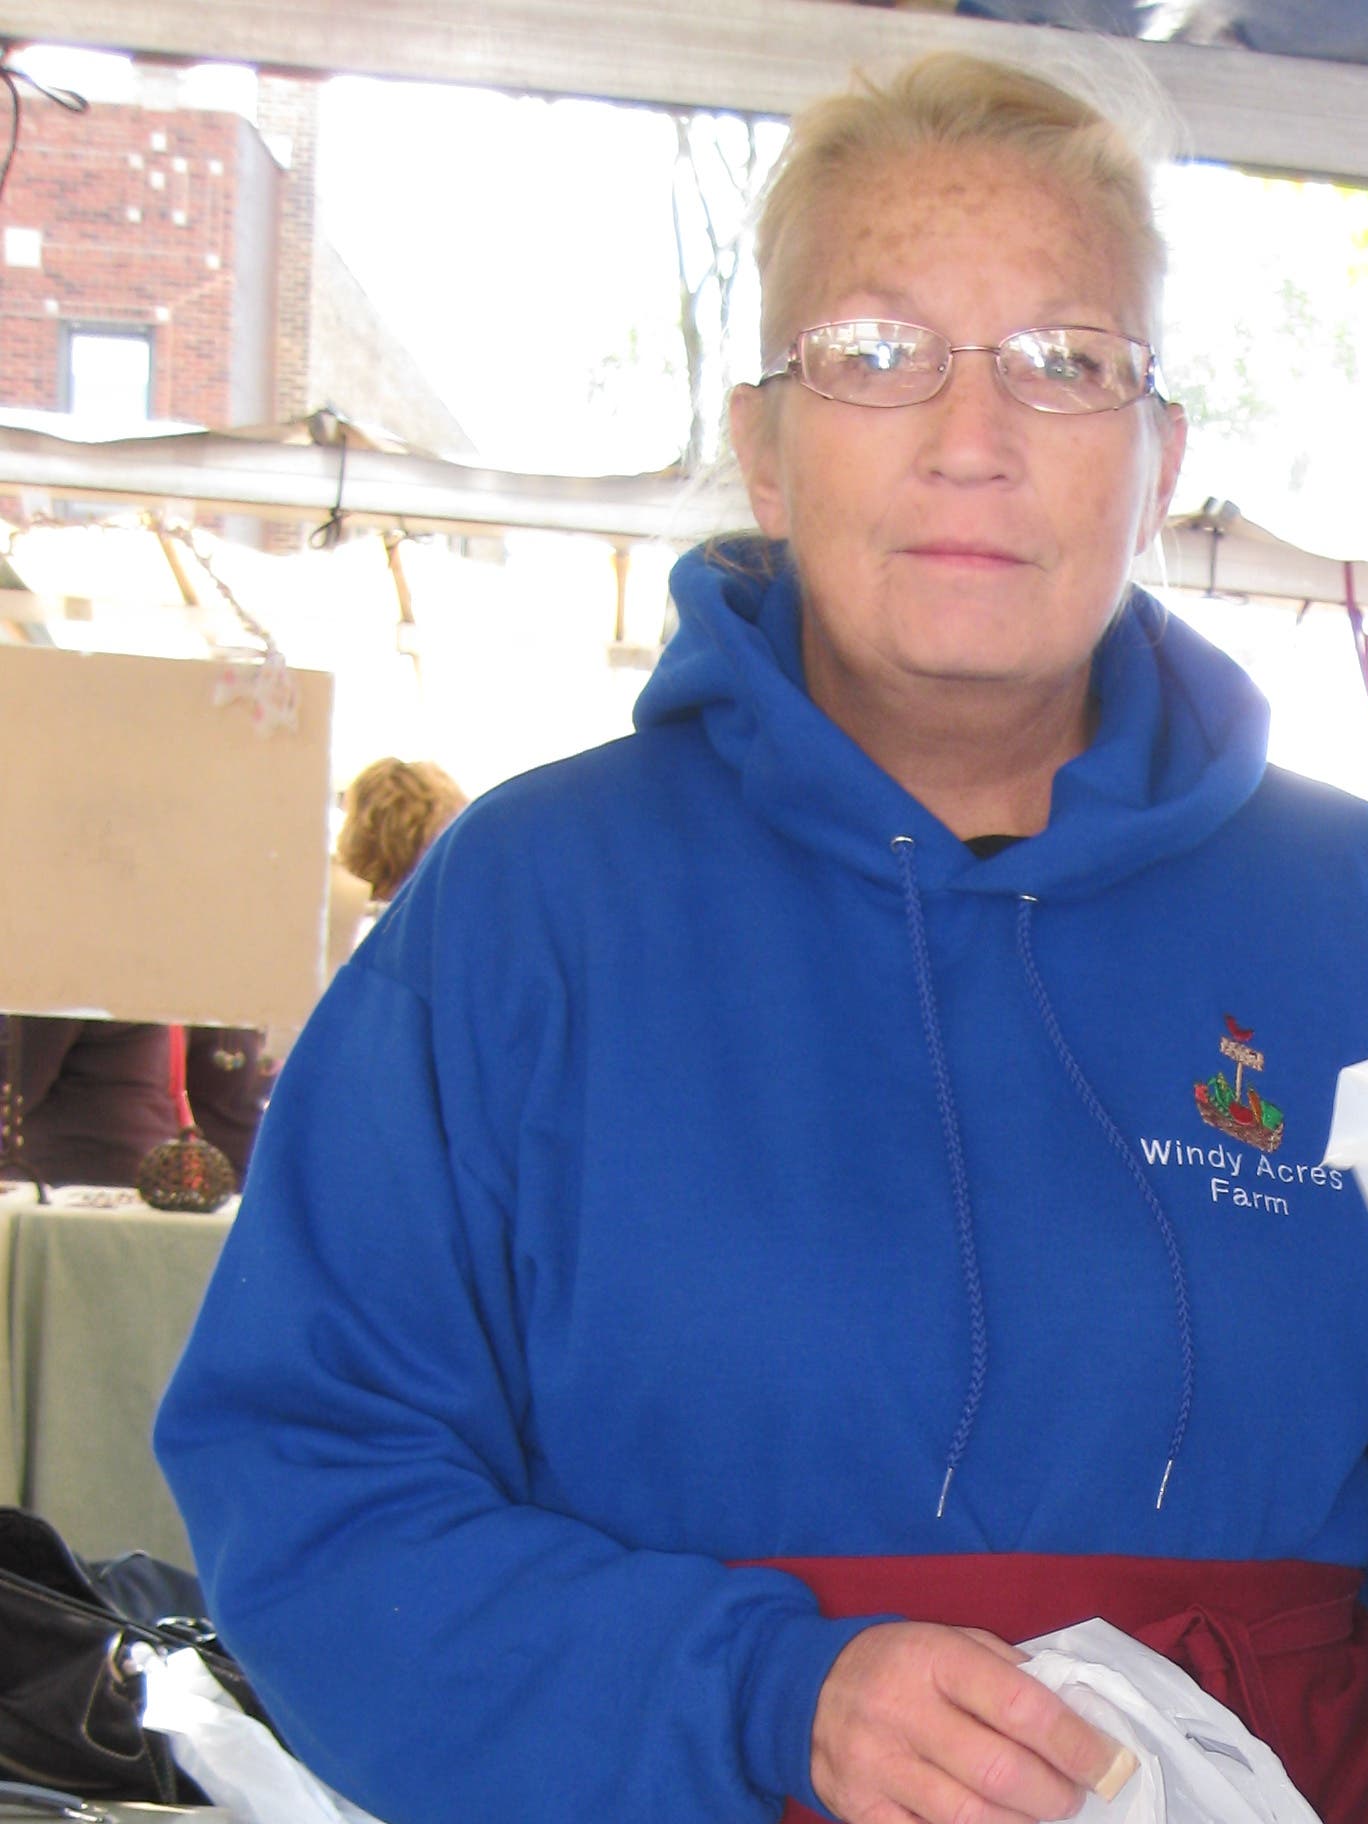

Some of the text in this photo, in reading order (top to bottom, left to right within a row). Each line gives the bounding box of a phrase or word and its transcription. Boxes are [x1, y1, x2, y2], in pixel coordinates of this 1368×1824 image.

[1139, 1138, 1344, 1190] Windy Acres
[1210, 1177, 1290, 1216] Farm
